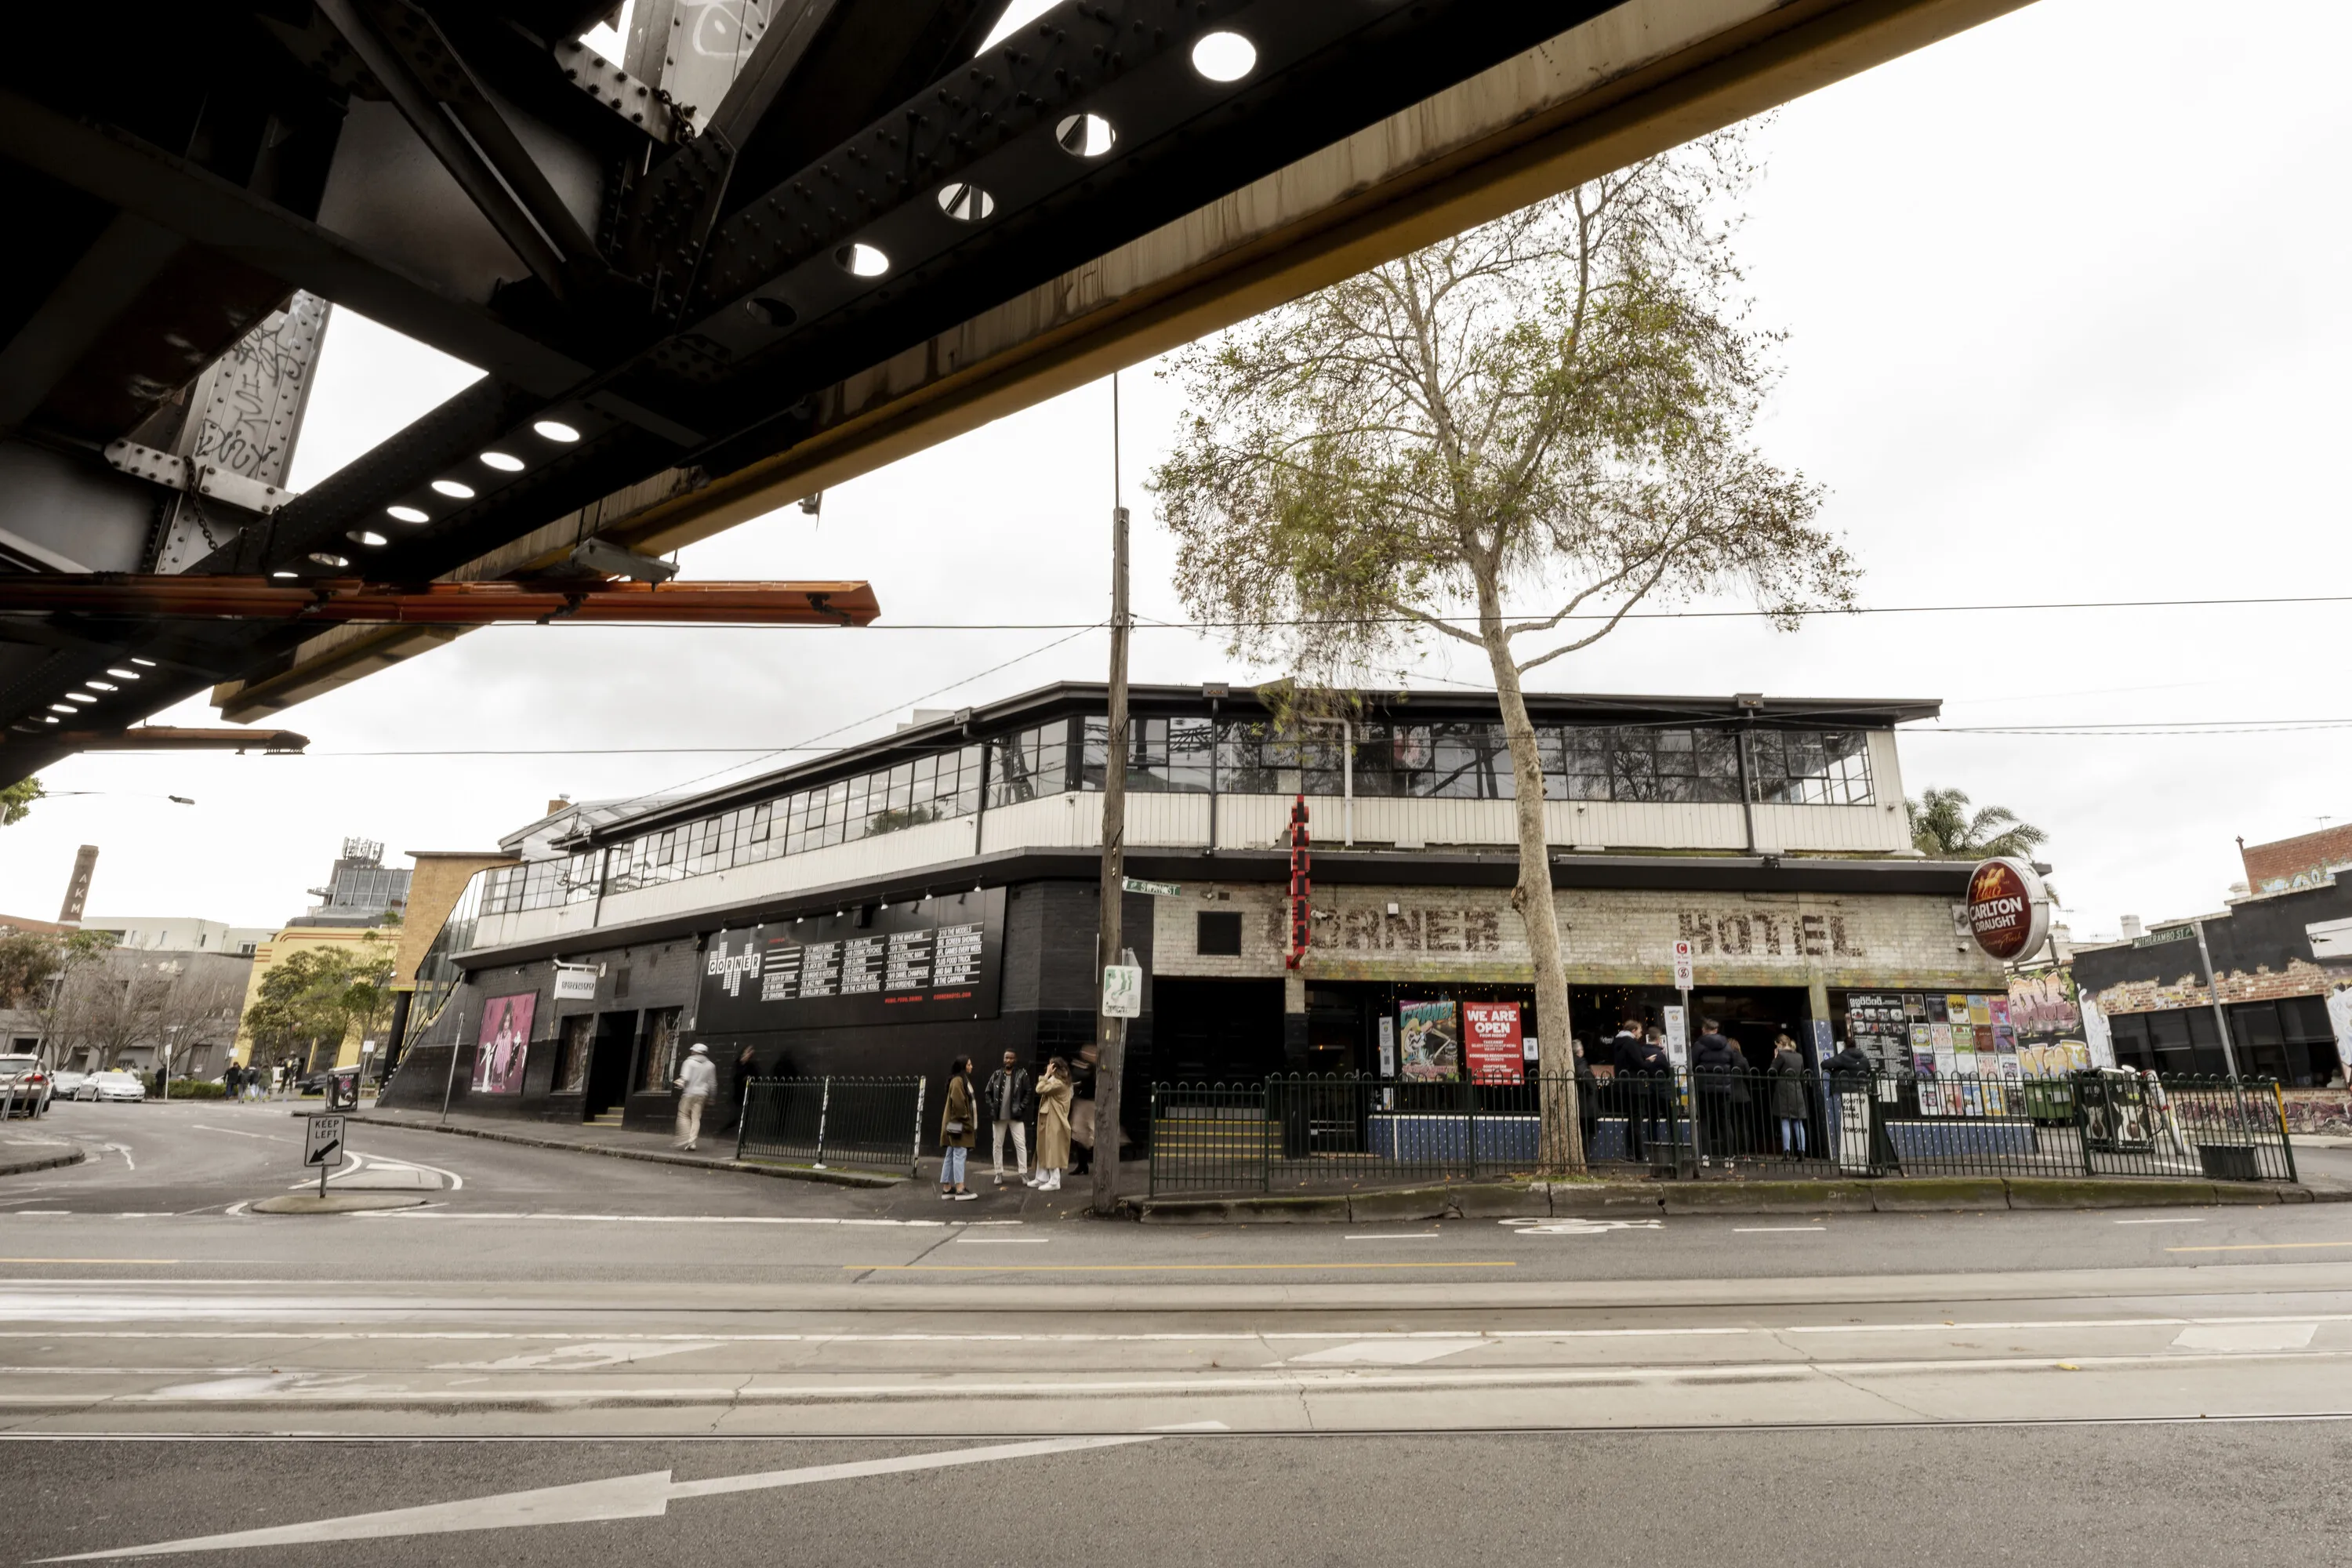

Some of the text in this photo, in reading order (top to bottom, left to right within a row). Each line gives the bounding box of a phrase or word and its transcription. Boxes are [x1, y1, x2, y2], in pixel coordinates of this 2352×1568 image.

[1167, 885, 1176, 895] ST
[1969, 896, 2024, 921] CARLTON
[1976, 914, 2016, 933] DRAUGHT
[956, 926, 972, 935] MODELS
[1678, 911, 1867, 956] HOTEL
[946, 937, 961, 946] SCREEN
[962, 935, 981, 944] SHOWING
[2133, 929, 2183, 947] ROTHERAMBO ST
[945, 946, 957, 955] GAMES
[970, 943, 982, 952] WEEK
[710, 956, 758, 972] CORNER
[946, 956, 956, 964] FOOD
[958, 954, 971, 963] TRUCK
[947, 975, 966, 983] CARPARK
[1401, 1002, 1454, 1028] CORNER
[1467, 1010, 1517, 1022] WE ARE
[1475, 1022, 1510, 1033] OPEN
[315, 1120, 339, 1129] KEEP
[315, 1130, 337, 1139] LEFT
